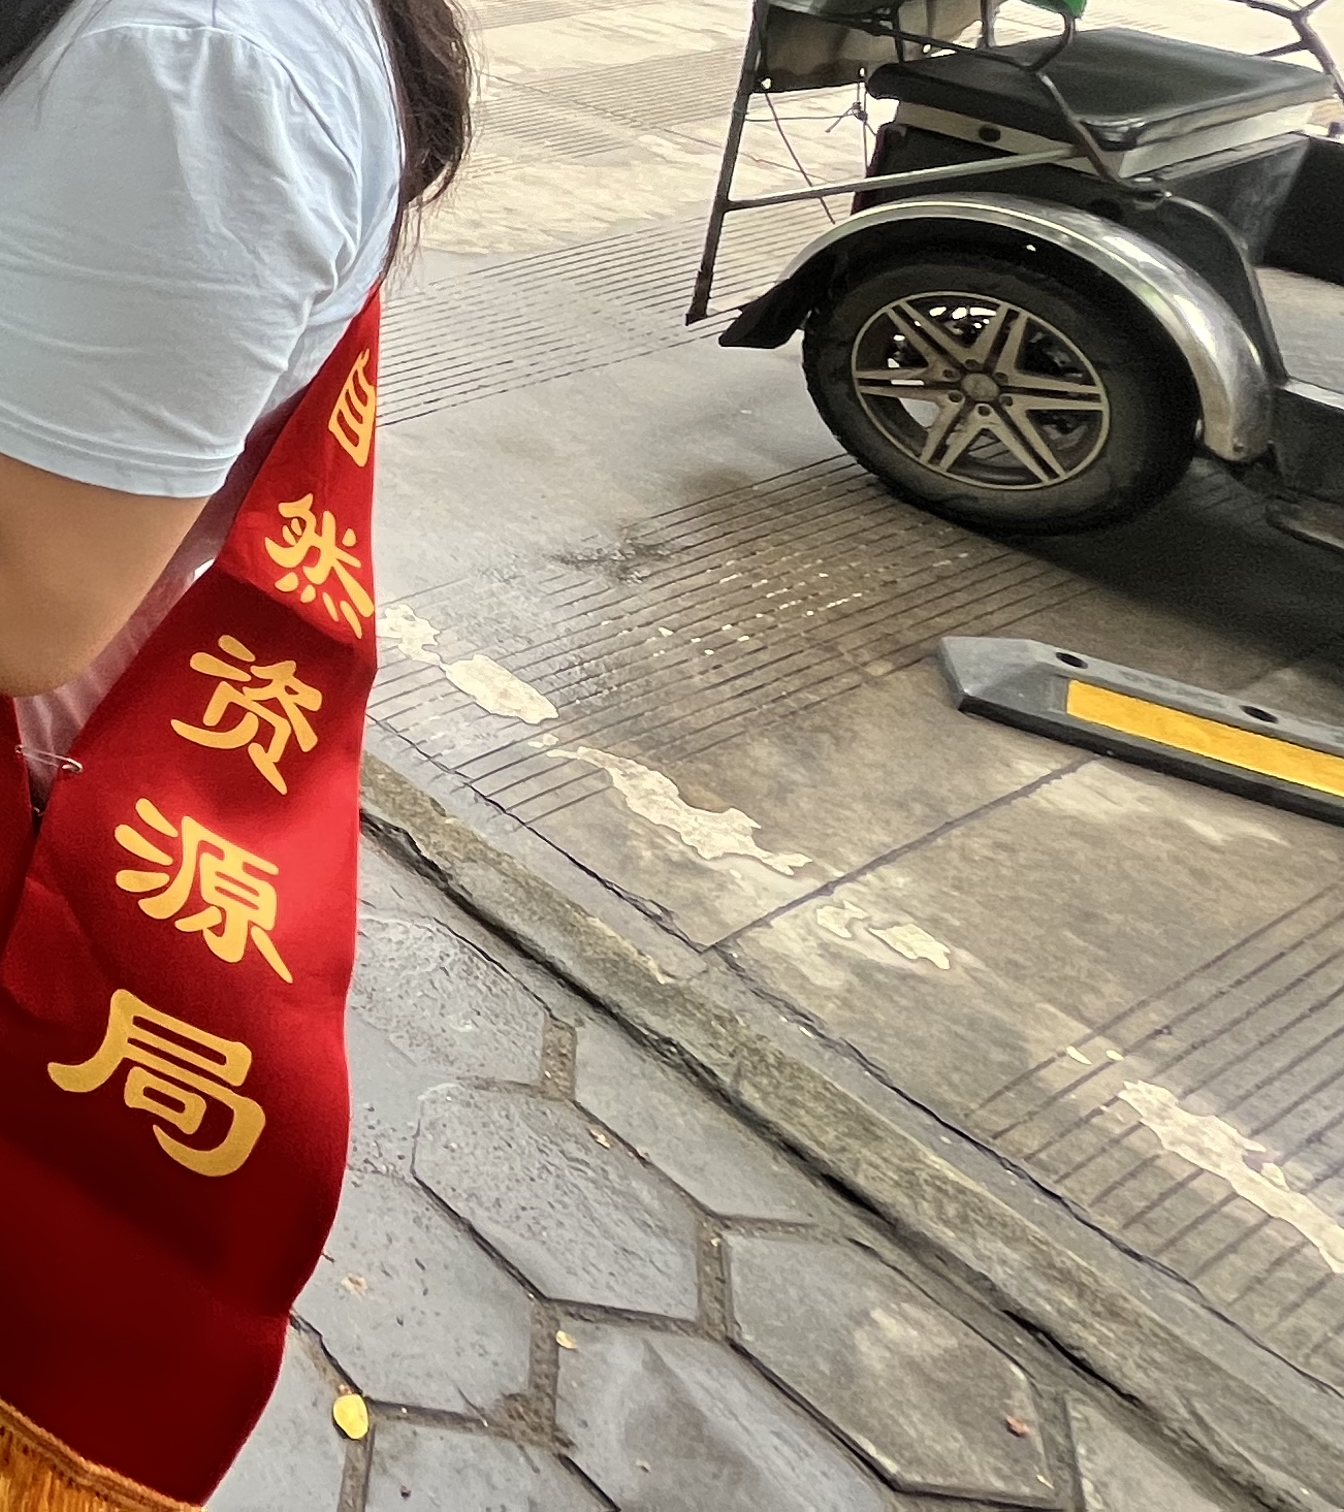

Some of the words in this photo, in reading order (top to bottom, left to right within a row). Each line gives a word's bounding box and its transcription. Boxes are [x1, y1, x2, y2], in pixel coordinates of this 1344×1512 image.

[47, 349, 377, 1177] 自然资源局
